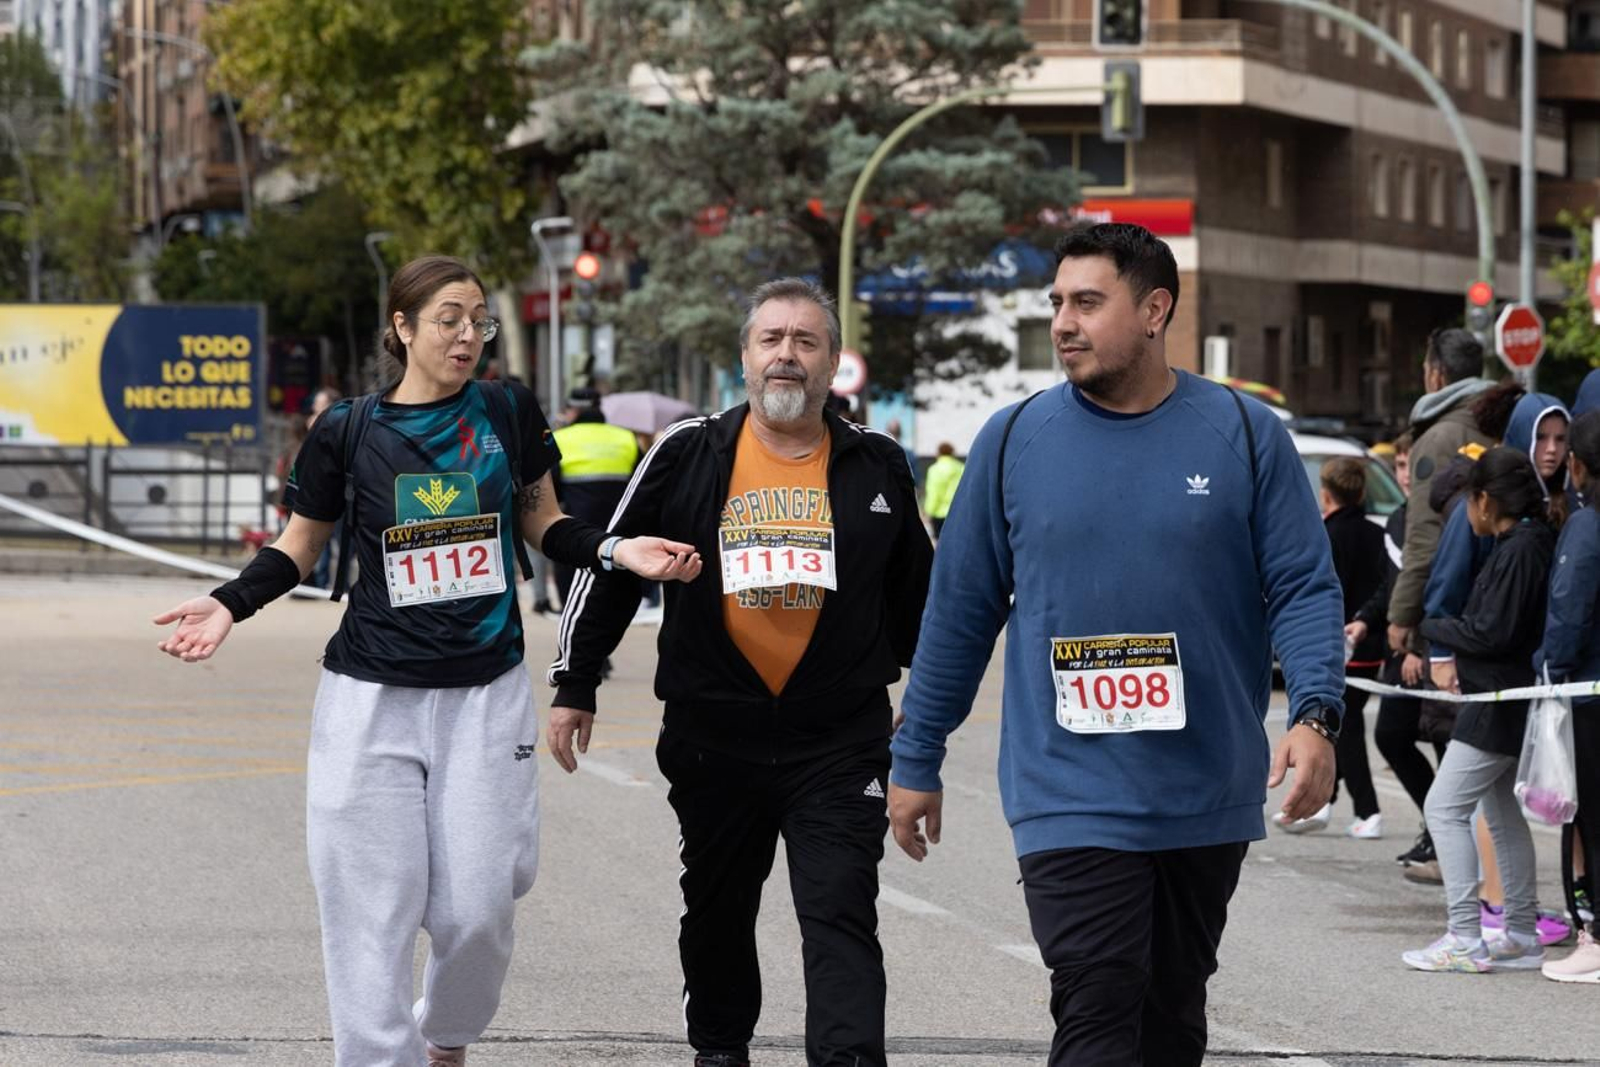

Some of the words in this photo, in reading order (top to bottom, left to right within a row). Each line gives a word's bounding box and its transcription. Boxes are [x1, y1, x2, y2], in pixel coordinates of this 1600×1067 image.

[1503, 327, 1539, 346] STOP
[179, 335, 252, 358] TODO
[162, 361, 195, 383] LO
[200, 361, 251, 383] QUE
[123, 386, 252, 409] NECESITAS
[721, 487, 832, 526] SPRINGFI
[414, 522, 452, 534] CARRERA
[454, 518, 494, 529] POPULAR
[425, 529, 447, 539] gran
[451, 524, 494, 534] caminata
[388, 528, 412, 544] XXV
[725, 529, 748, 543] XXV
[787, 534, 829, 543] caminata
[398, 545, 490, 585] 1112
[736, 549, 823, 574] 1113
[1055, 641, 1081, 660] XXV
[1083, 640, 1127, 650] CARRERA
[1129, 639, 1171, 648] POPULAR
[1096, 648, 1121, 658] gran
[1126, 646, 1172, 656] caminata
[1070, 672, 1170, 710] 1098
